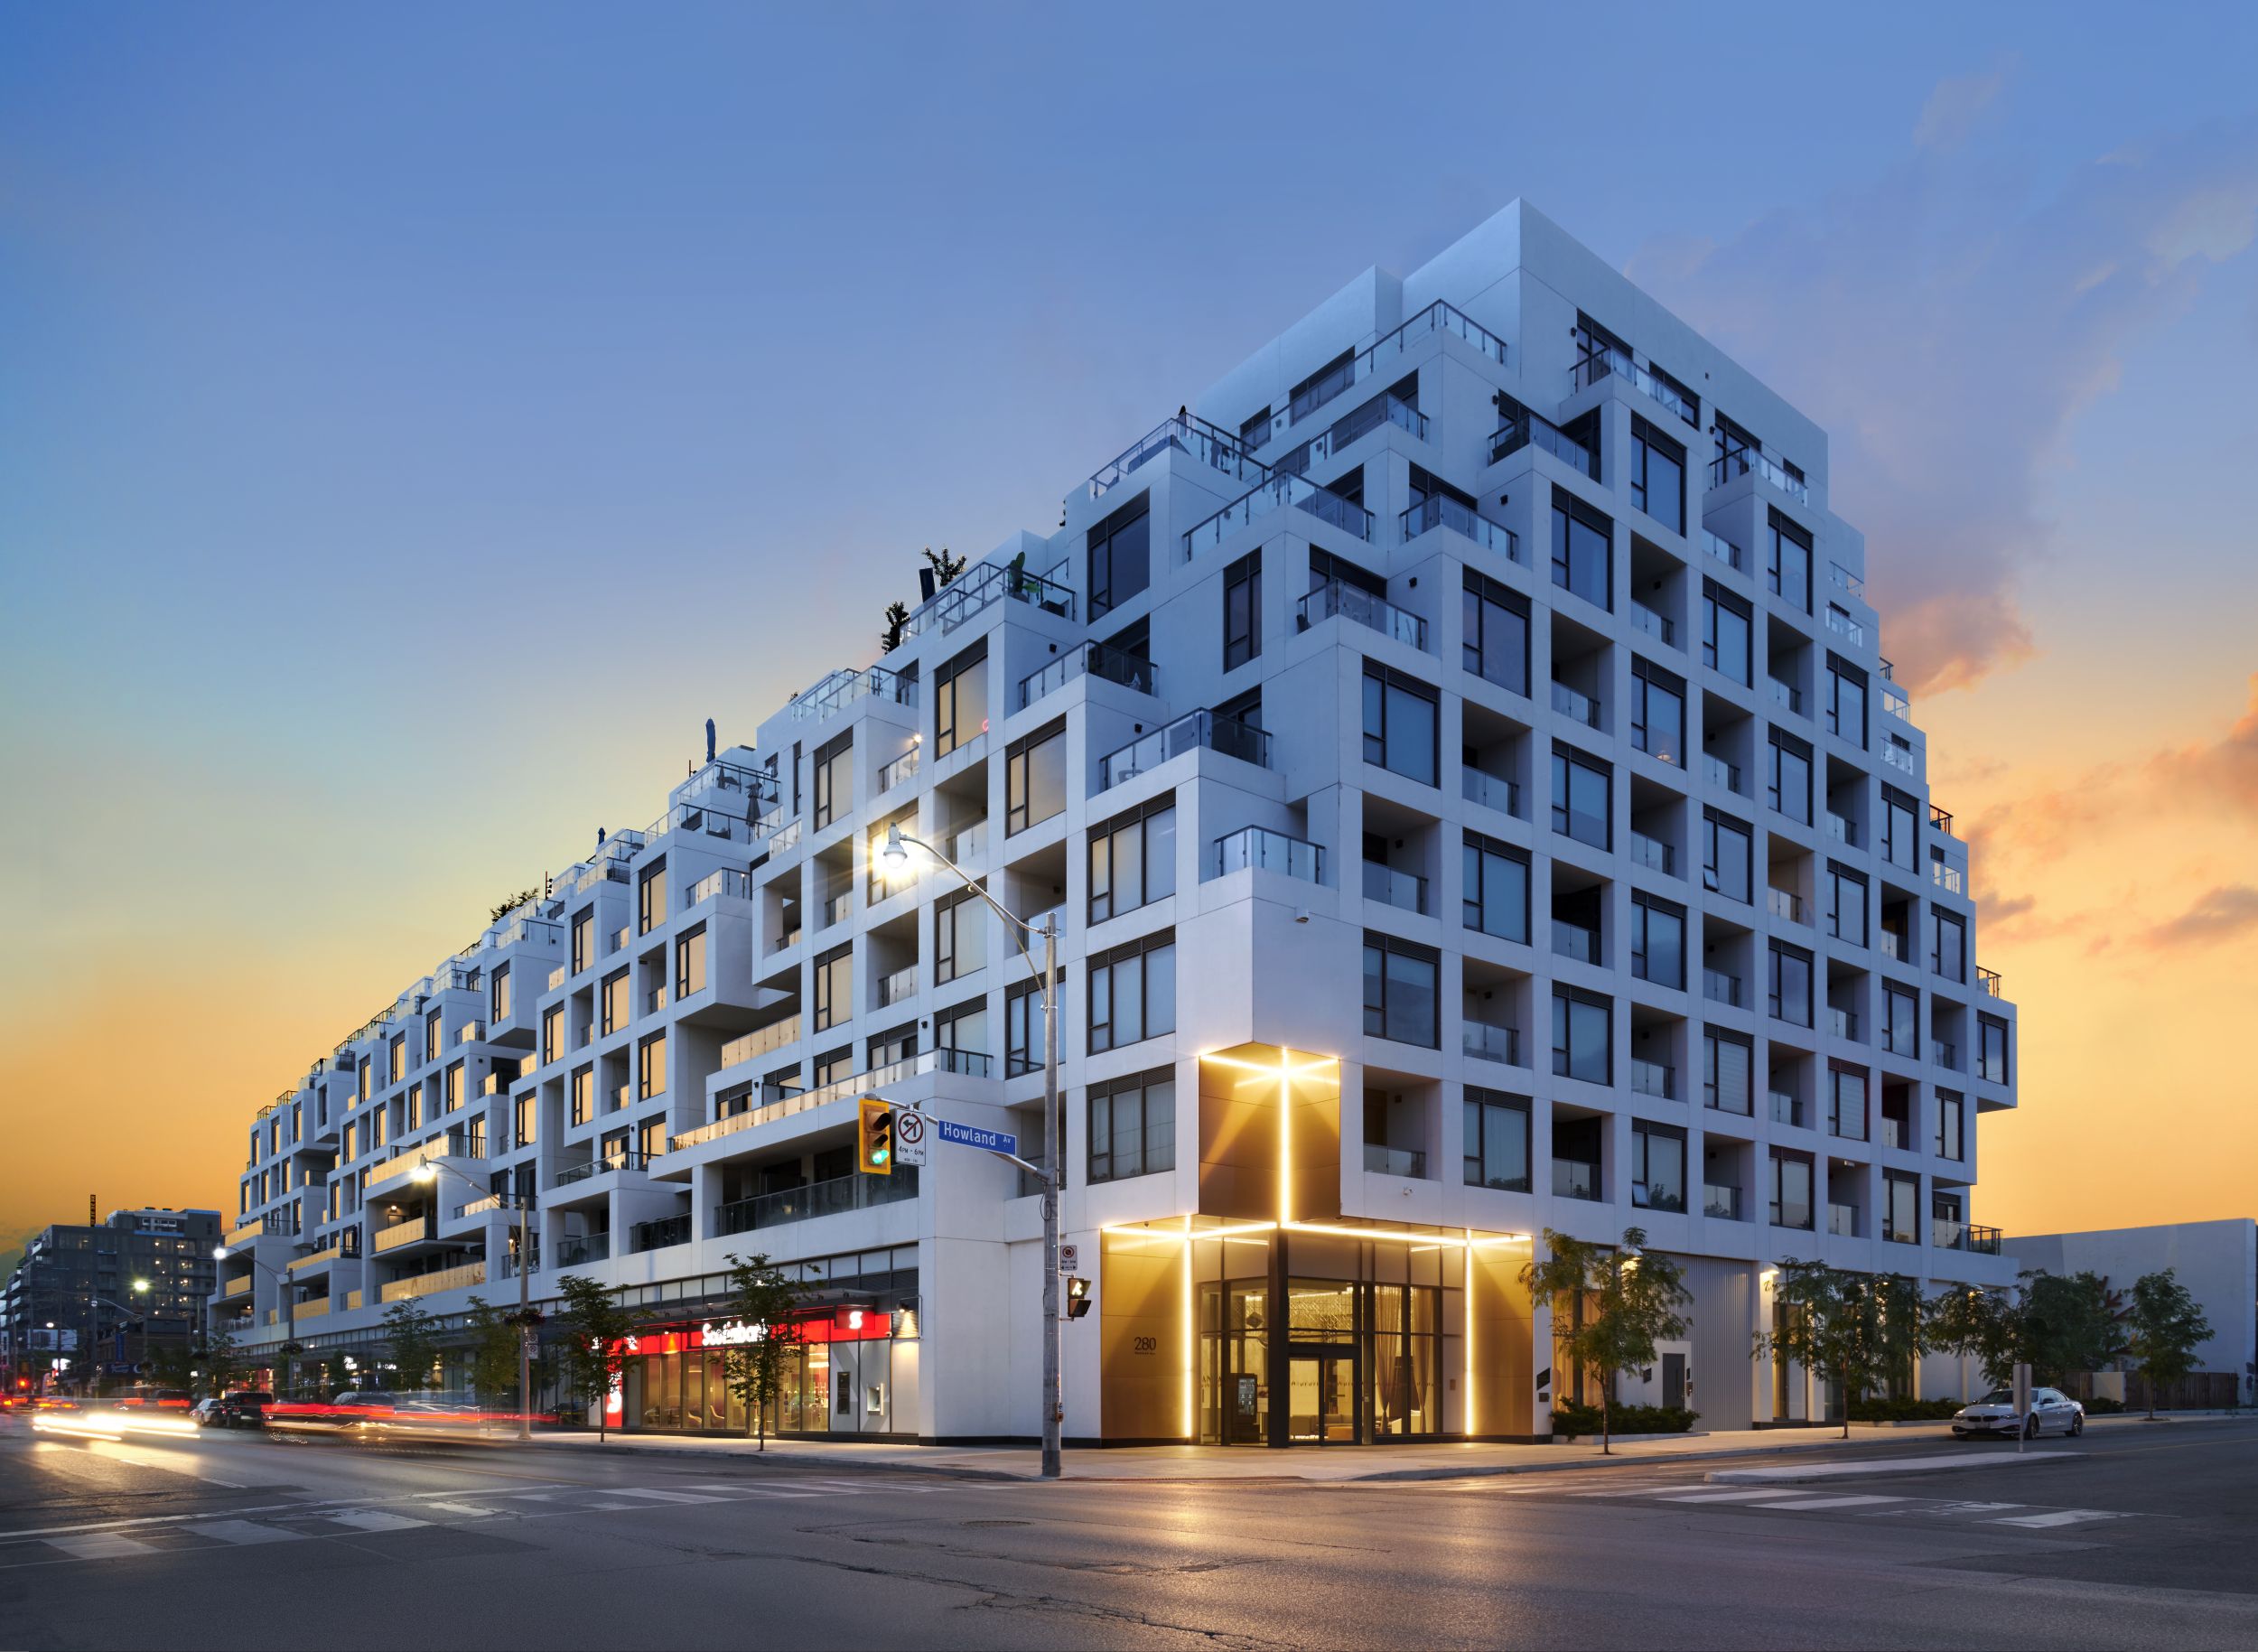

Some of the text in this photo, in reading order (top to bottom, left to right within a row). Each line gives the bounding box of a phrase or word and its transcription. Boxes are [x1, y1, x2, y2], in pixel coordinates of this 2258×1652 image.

[944, 1122, 1012, 1146] Howland Av
[1134, 1336, 1156, 1350] 280
